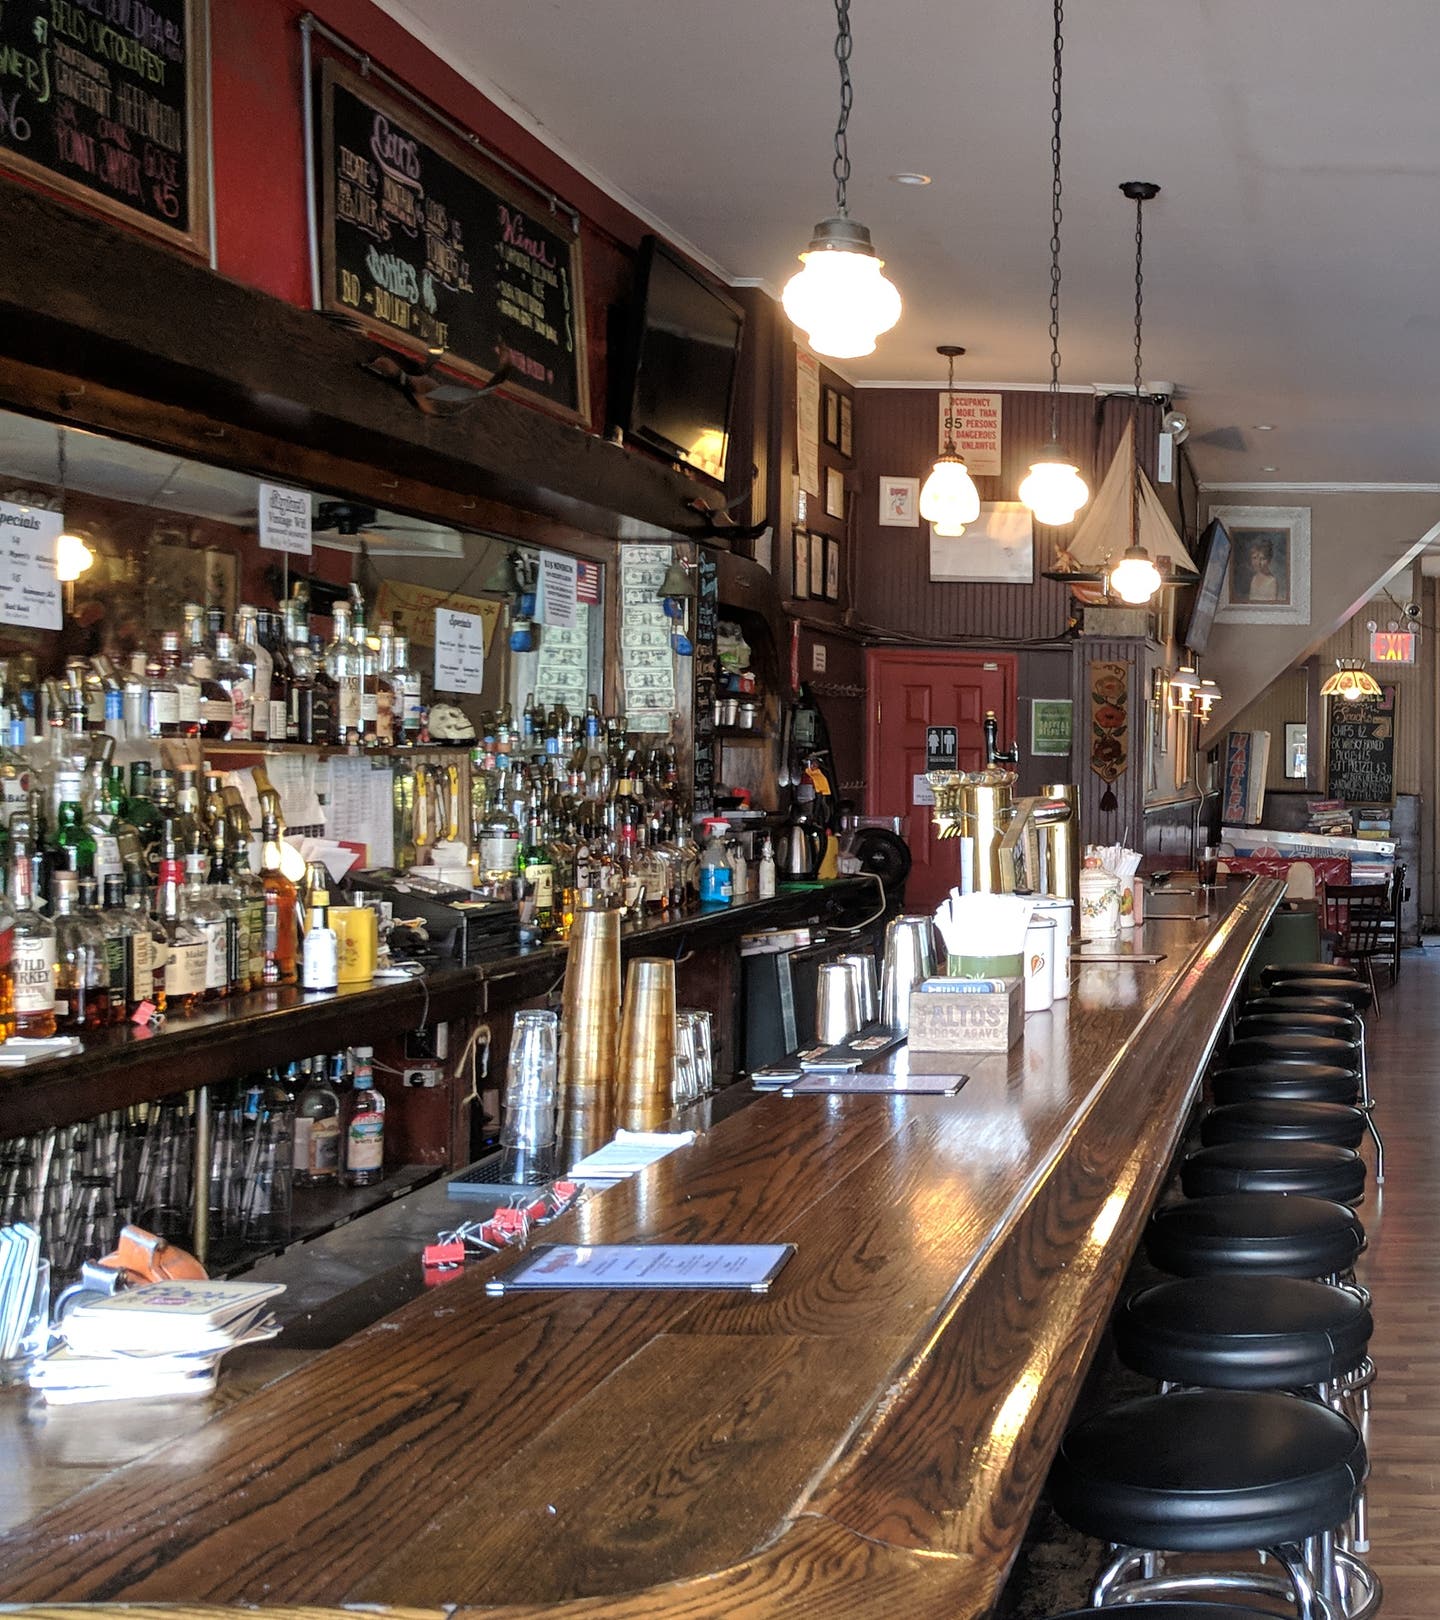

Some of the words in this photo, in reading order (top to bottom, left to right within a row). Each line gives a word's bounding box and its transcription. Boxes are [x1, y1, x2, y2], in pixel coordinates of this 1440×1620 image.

[956, 408, 975, 417] MORE
[980, 409, 998, 417] THAN
[944, 417, 963, 430] 85
[966, 420, 998, 429] PERSONS
[956, 430, 997, 439] DANGEROUS
[961, 441, 997, 450] UNLAWFUL
[0, 512, 41, 530] pecials
[1374, 633, 1412, 660] EXIT
[1332, 724, 1355, 738] CHIPS
[1226, 734, 1248, 822] HARLEM
[929, 1004, 1002, 1028] ALTOS
[963, 1028, 1000, 1039] AGAVE
